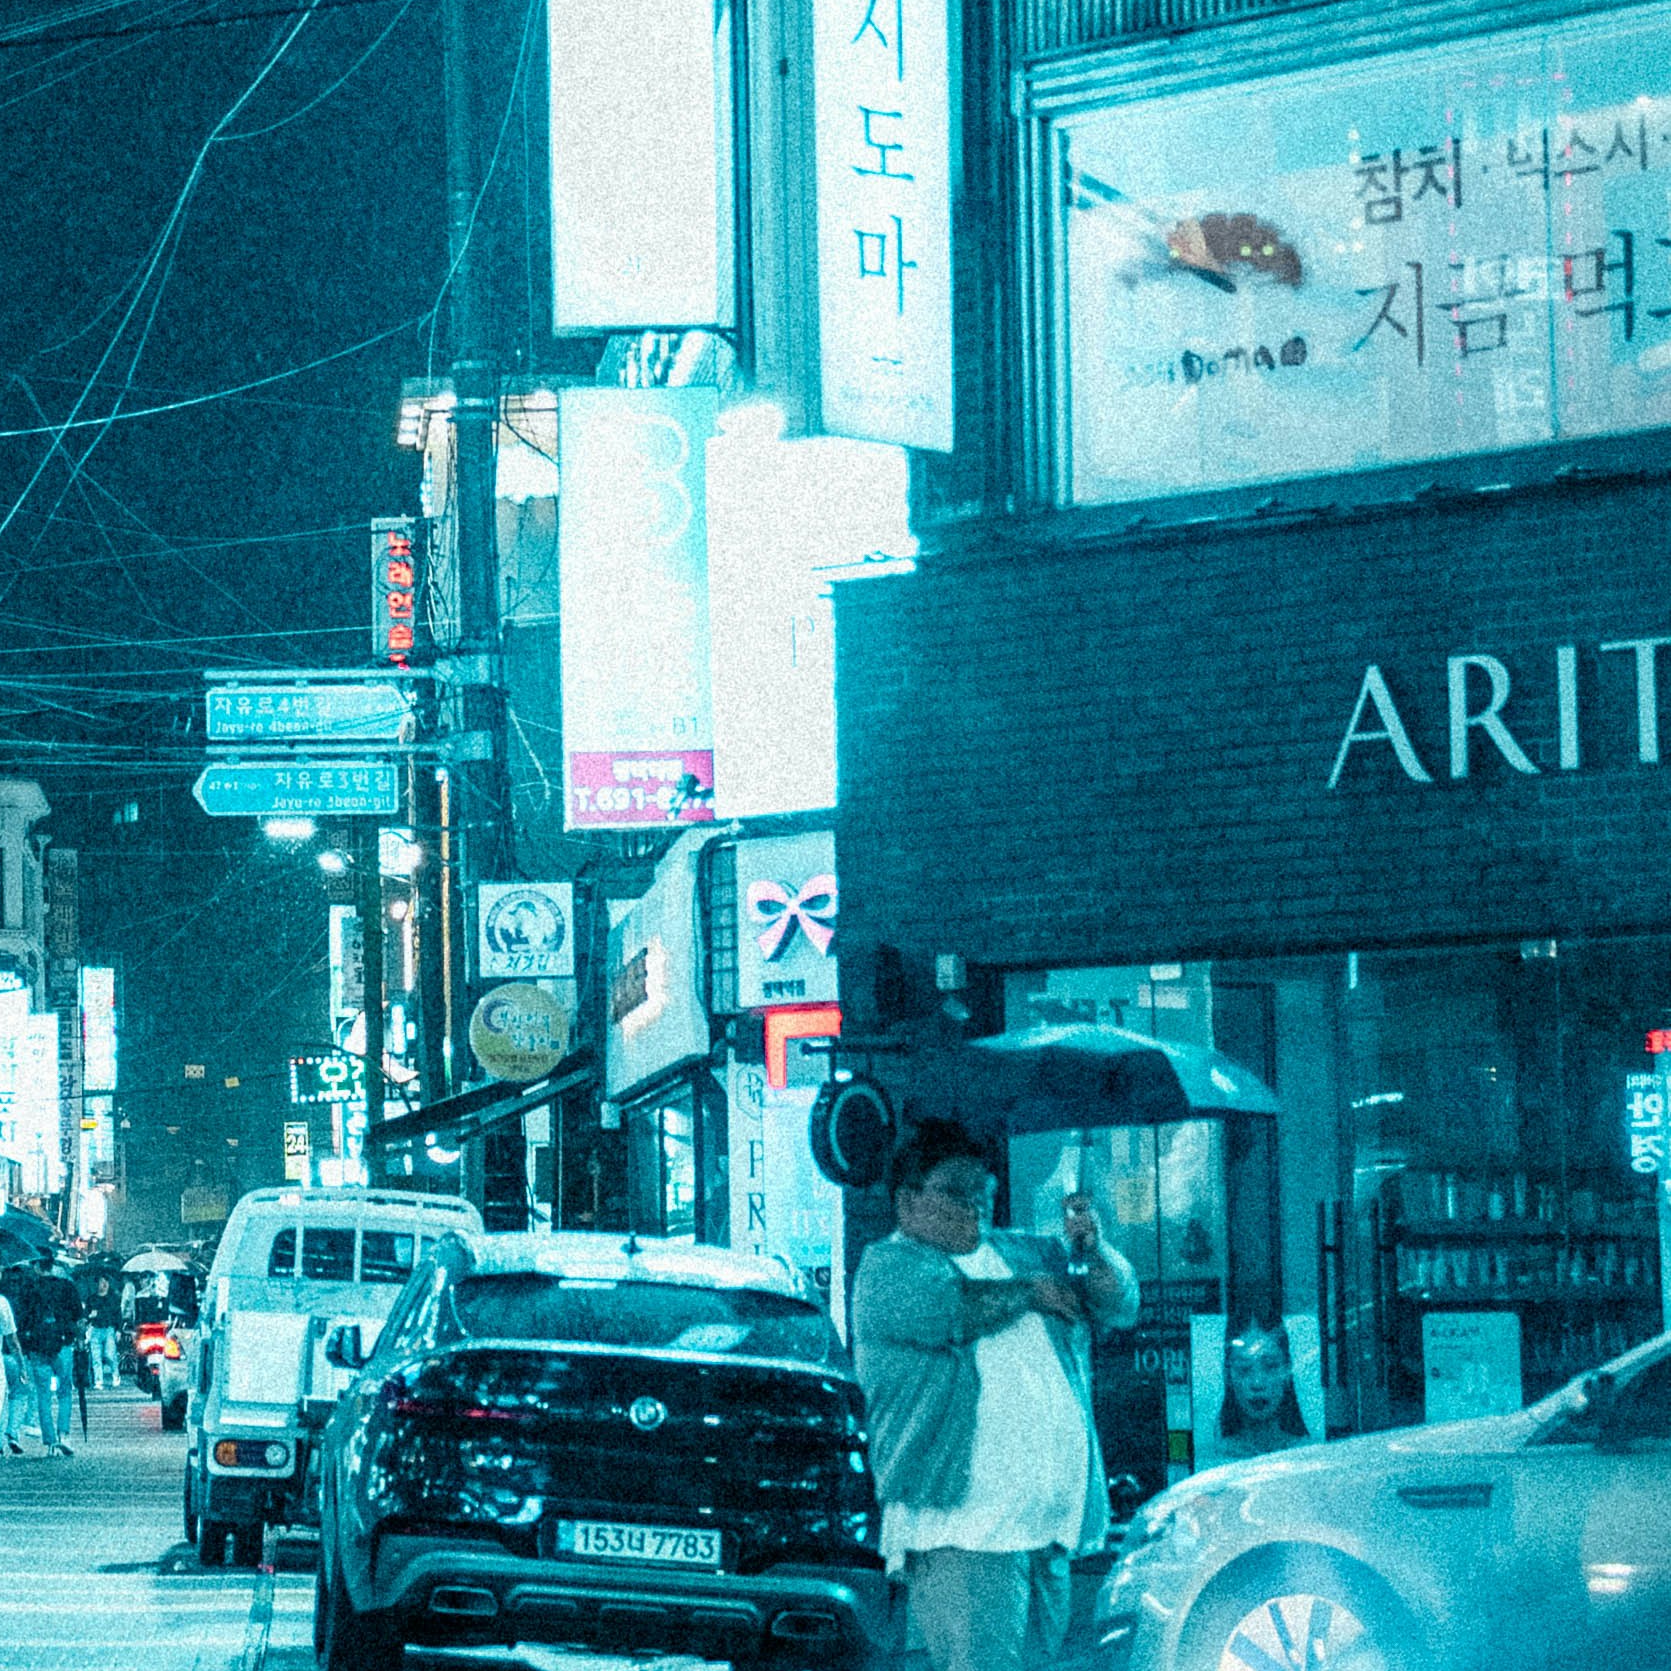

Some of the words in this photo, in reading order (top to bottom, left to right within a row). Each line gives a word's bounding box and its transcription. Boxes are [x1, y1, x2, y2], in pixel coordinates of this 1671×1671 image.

[1356, 138, 1461, 224] 참치
[1351, 261, 1507, 368] 지금
[276, 771, 390, 792] 자유로3번길
